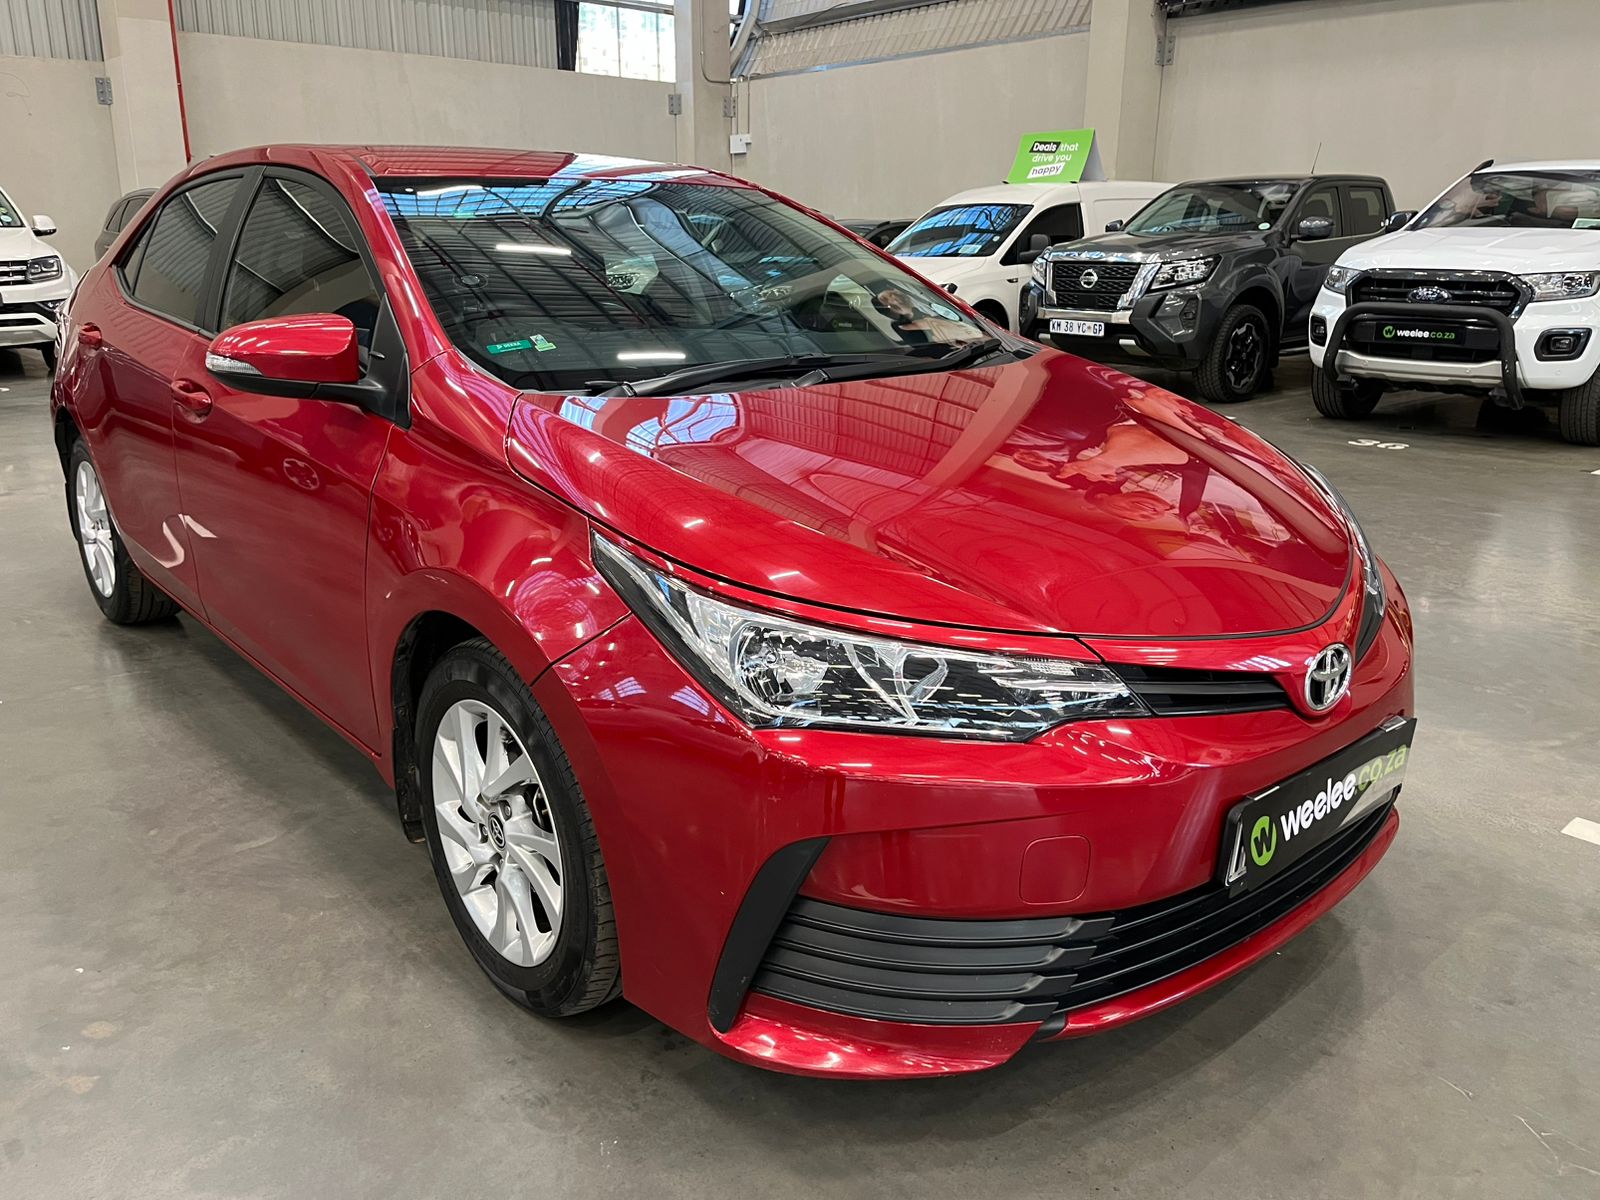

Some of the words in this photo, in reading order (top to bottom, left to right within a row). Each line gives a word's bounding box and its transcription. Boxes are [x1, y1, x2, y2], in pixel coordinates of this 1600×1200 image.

[1032, 142, 1057, 152] Deals
[1060, 142, 1079, 152] that
[1032, 153, 1054, 162] drive
[1055, 155, 1072, 164] you
[1031, 164, 1062, 176] happy
[1064, 321, 1074, 333] 38
[1077, 322, 1087, 334] YC
[1092, 323, 1103, 335] GP
[1396, 328, 1456, 339] weelee.co.za
[1280, 744, 1408, 841] weelee.co.za
